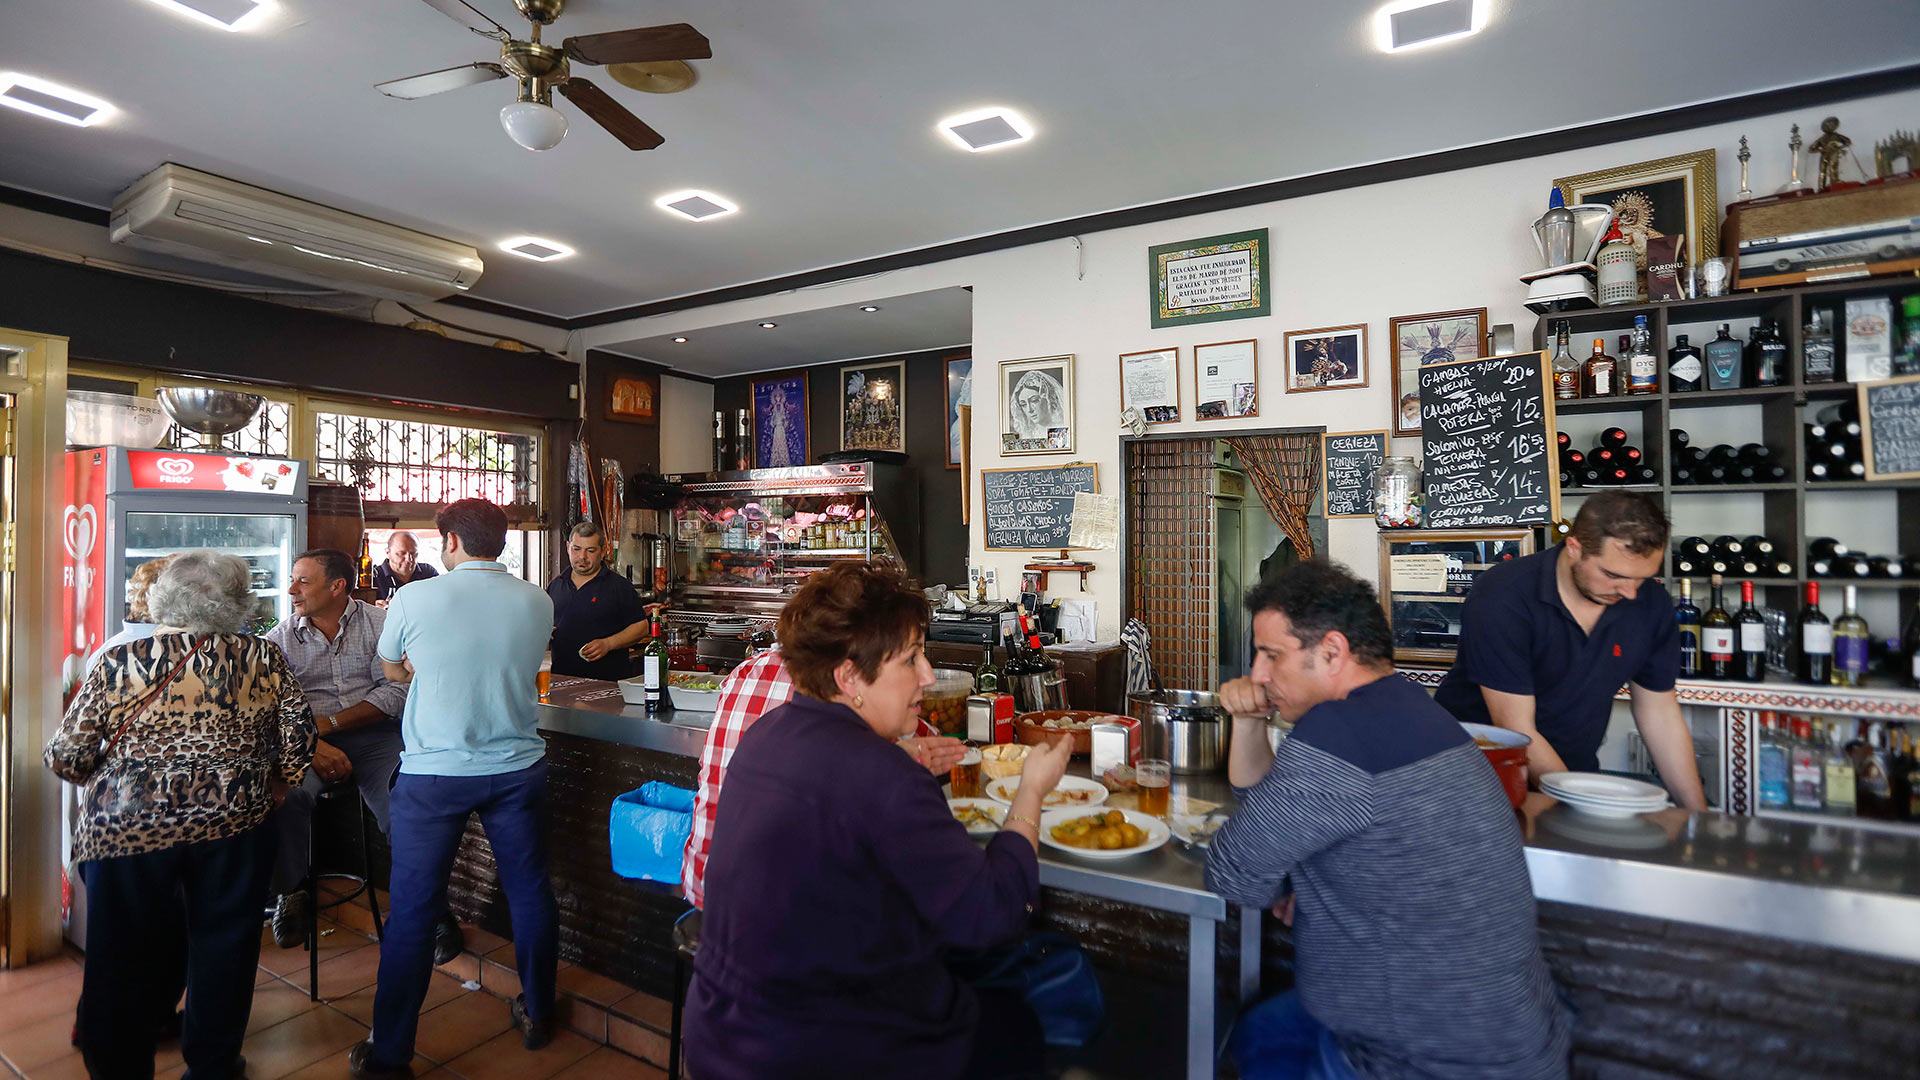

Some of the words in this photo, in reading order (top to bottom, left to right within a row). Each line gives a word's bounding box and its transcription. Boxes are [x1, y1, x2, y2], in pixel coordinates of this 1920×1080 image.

[1648, 262, 1684, 272] CARDHU
[1636, 360, 1656, 368] DYC
[126, 404, 162, 414] TORRES
[1332, 436, 1378, 449] CERVEZA
[1439, 447, 1488, 465] TERNERA
[160, 475, 192, 484] FRIGO
[1430, 505, 1484, 519] CORVINA
